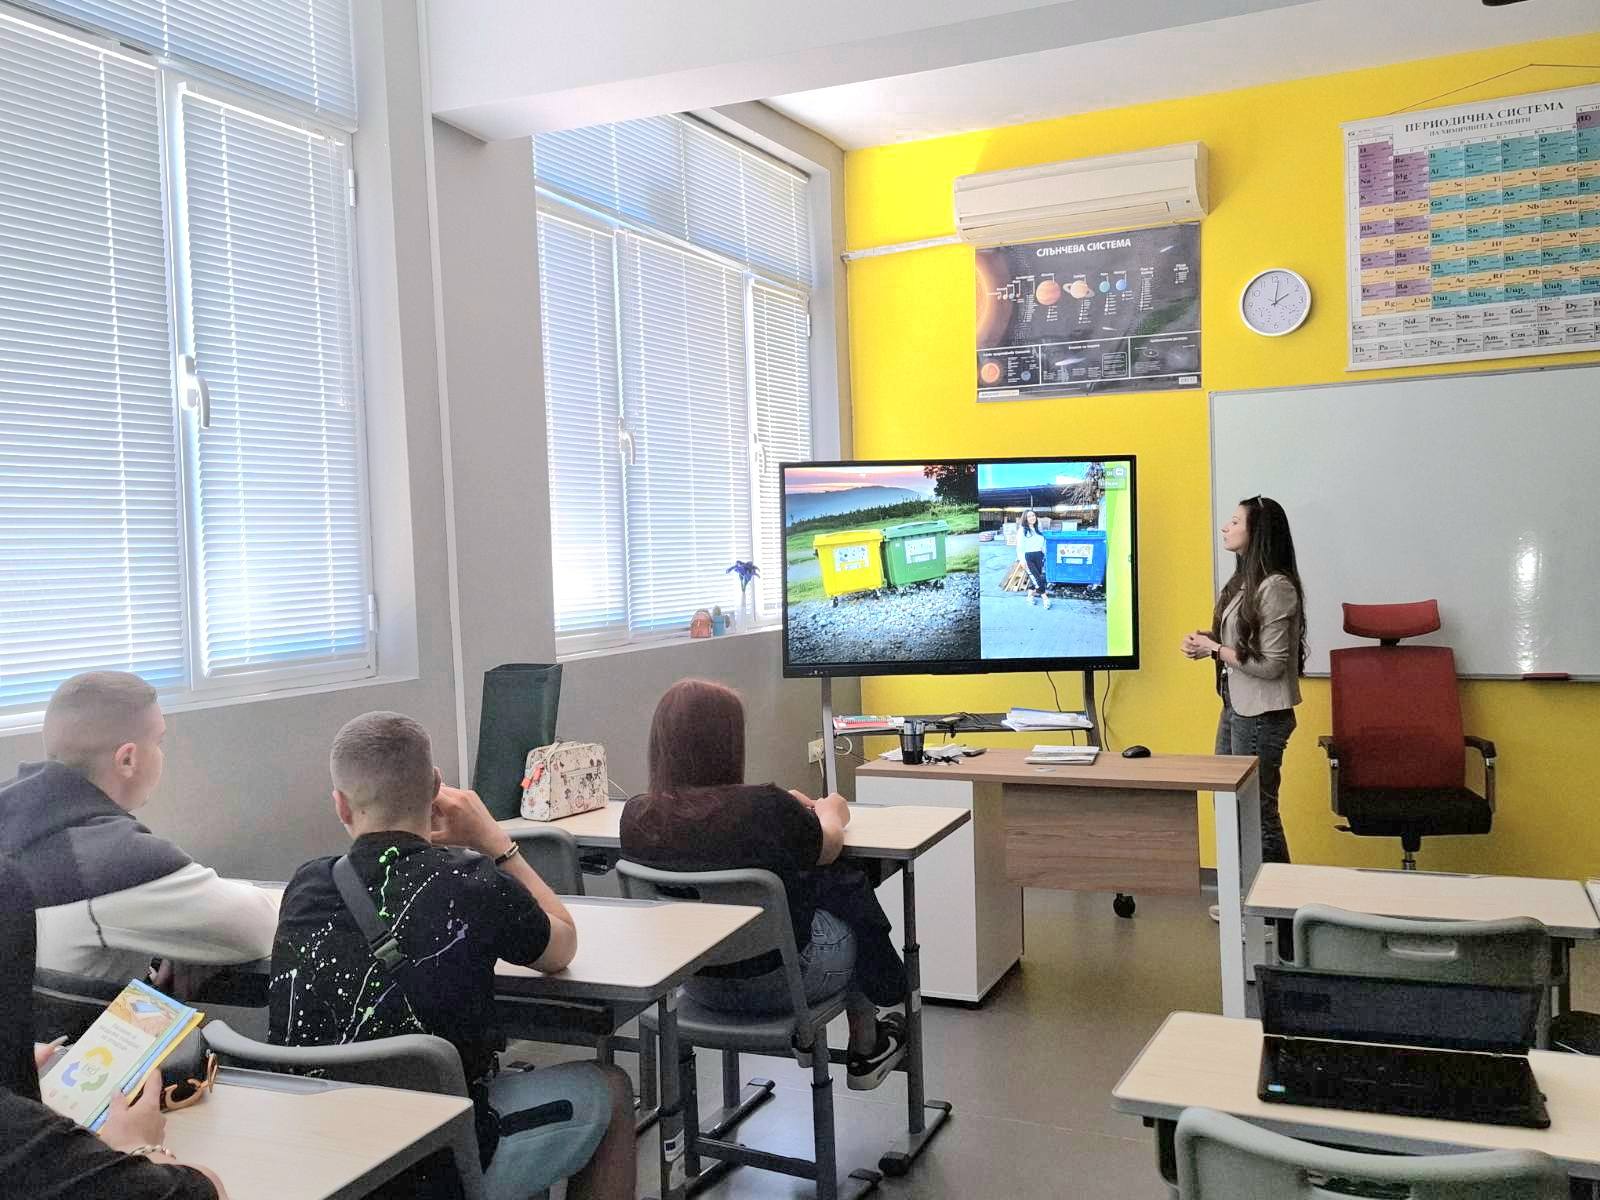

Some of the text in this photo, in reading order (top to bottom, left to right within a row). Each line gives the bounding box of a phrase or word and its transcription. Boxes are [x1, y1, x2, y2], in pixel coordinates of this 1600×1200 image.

[1406, 113, 1494, 132] ПЕРИОДИЧНА
[1498, 102, 1564, 118] СИСТЕМА
[1490, 117, 1531, 128] ЕЛЕМЕНТИ
[1036, 238, 1132, 257] СЛЪНЧЕВА СИСТЕМА
